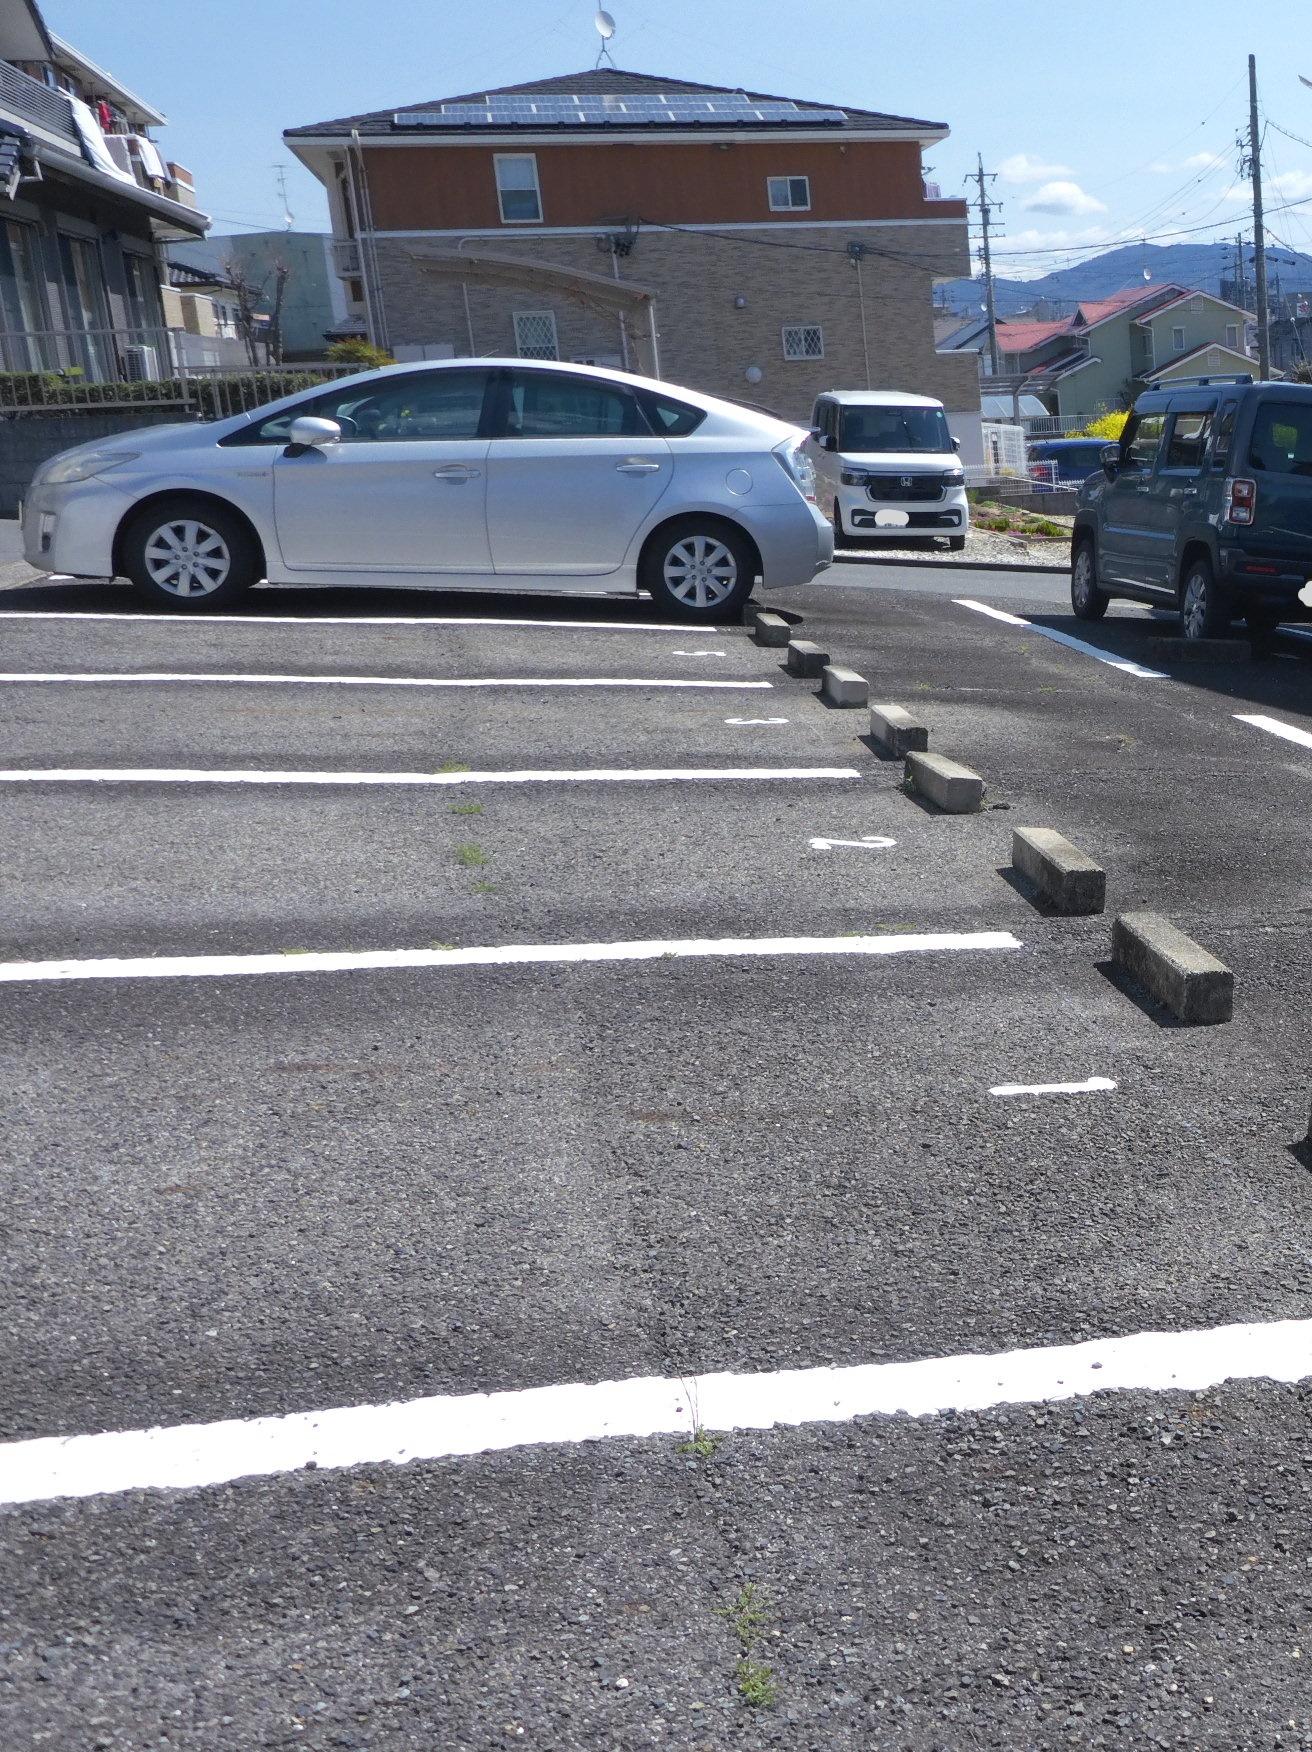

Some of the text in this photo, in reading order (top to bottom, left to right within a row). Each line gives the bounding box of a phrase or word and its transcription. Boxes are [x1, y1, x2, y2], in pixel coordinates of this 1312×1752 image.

[672, 649, 728, 658] 5
[723, 717, 790, 726] 3
[807, 834, 898, 851] 2
[987, 1076, 1119, 1097] 1
